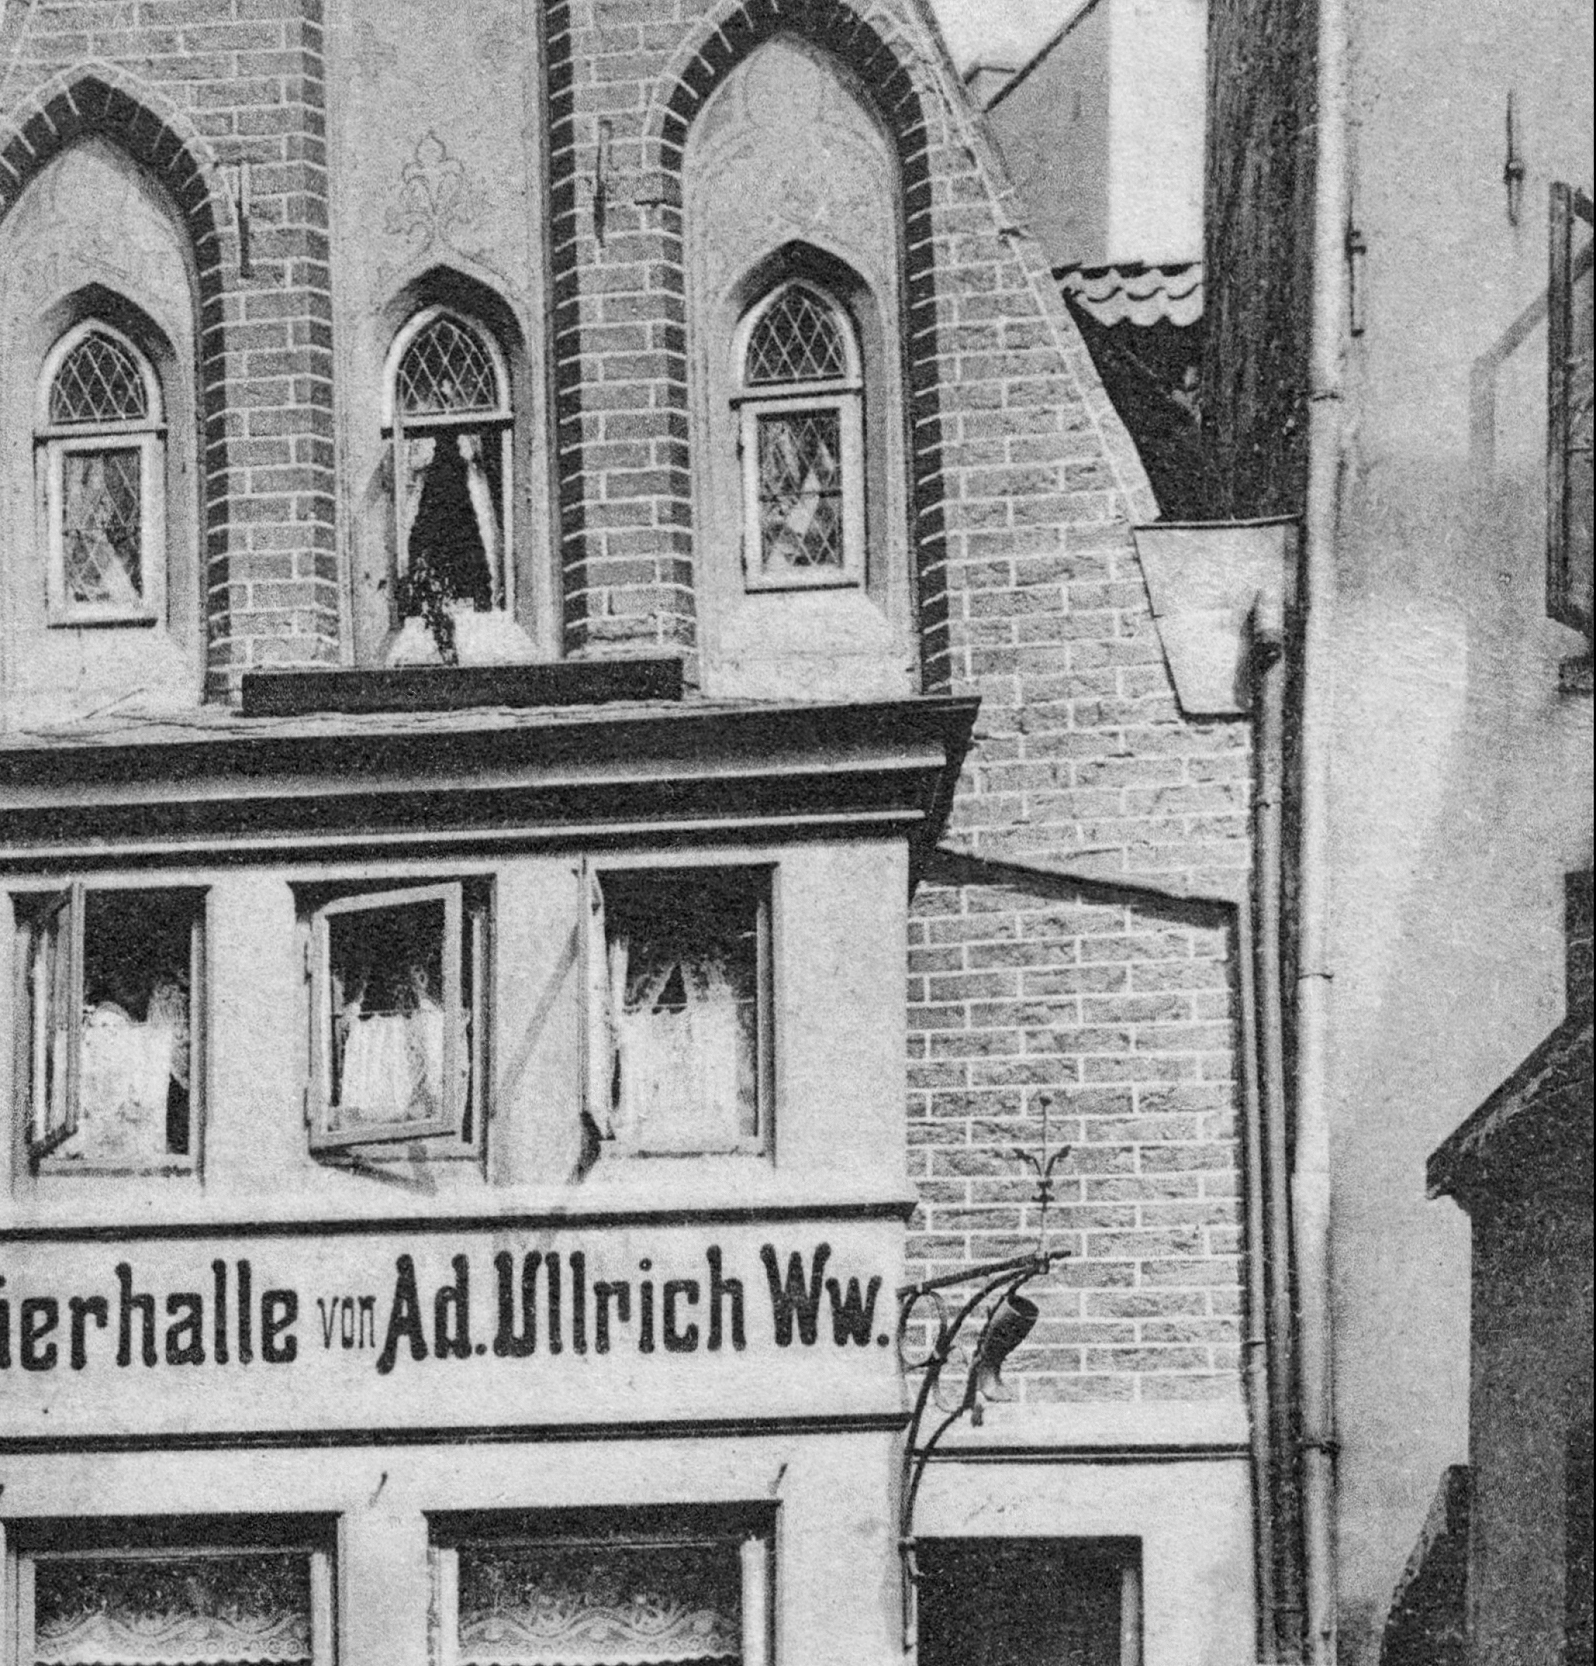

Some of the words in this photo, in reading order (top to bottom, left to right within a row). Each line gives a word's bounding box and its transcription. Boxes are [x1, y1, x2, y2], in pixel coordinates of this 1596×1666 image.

[317, 1296, 376, 1351] von
[376, 1253, 487, 1375] Ad.
[495, 1245, 747, 1359] Ullrich
[760, 1243, 891, 1349] Ww.
